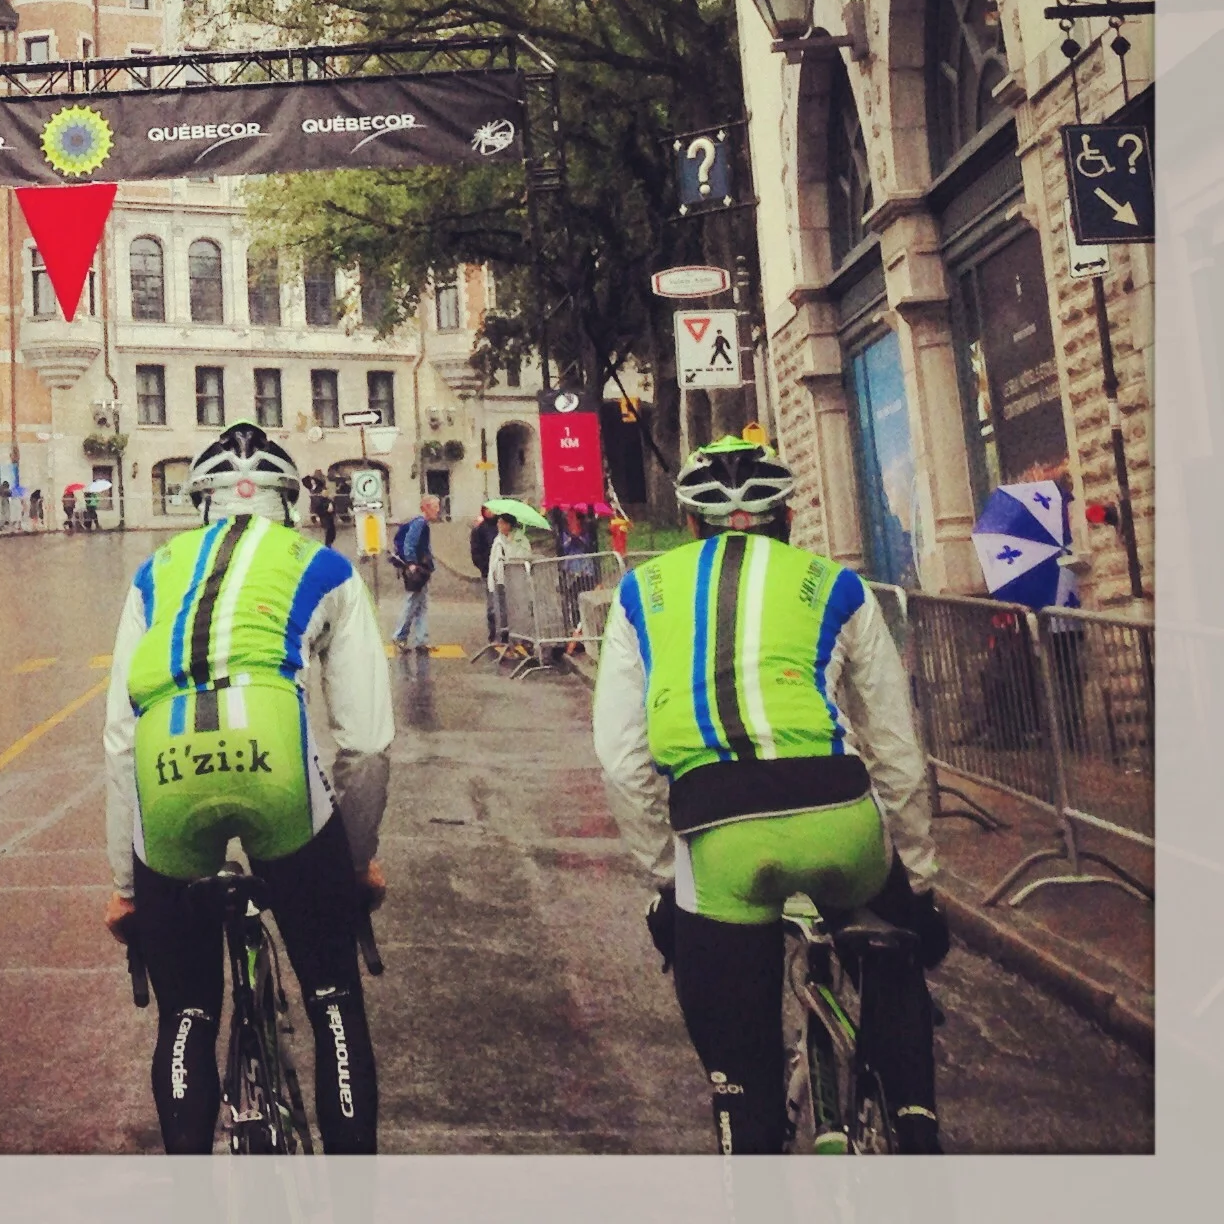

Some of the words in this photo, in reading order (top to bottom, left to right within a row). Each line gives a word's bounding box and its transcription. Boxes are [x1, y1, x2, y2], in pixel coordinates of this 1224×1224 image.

[148, 122, 261, 142] QUÉBECOR
[302, 114, 416, 134] QUÉBECOR
[564, 426, 570, 437] 1
[560, 438, 580, 449] KM
[171, 1017, 192, 1099] cannondale
